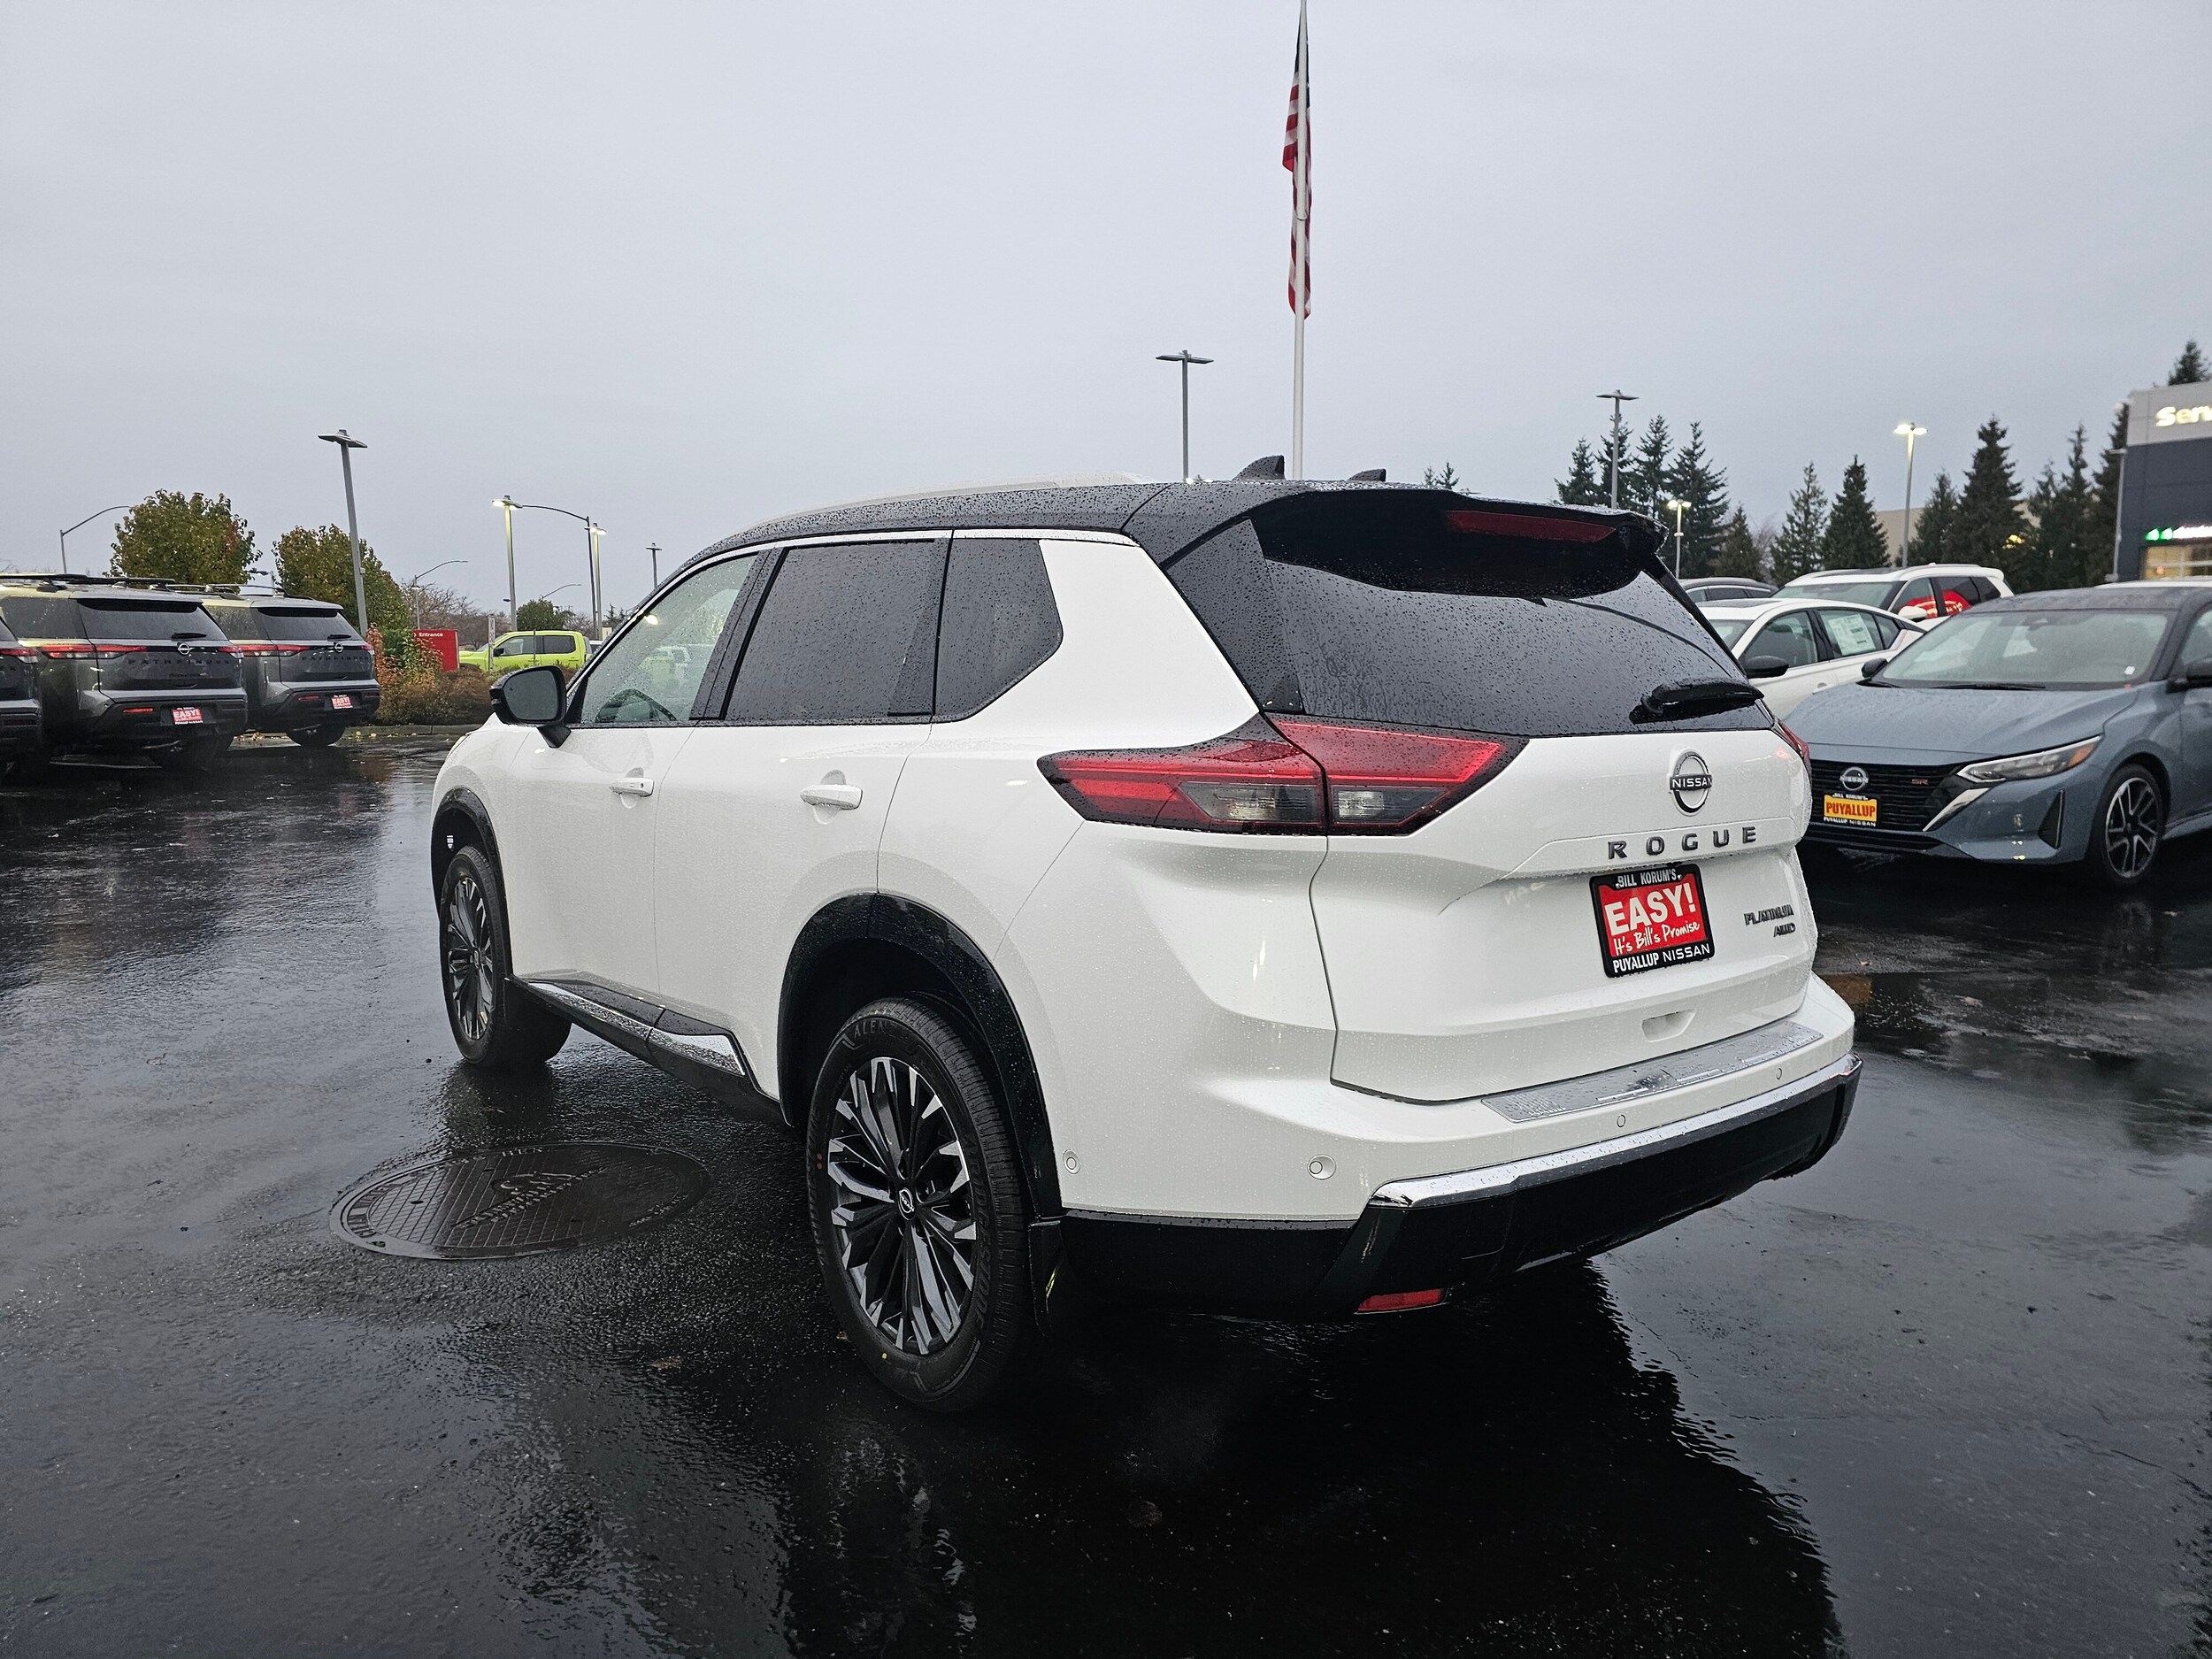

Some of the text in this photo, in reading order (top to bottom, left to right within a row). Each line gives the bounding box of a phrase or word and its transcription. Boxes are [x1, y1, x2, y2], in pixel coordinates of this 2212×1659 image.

[1671, 776, 1713, 788] NISSAN
[1825, 802, 1876, 818] PUYALLUP
[1608, 826, 1757, 859] ROGUE
[1617, 868, 1677, 887] BILL KORUM'S
[1604, 883, 1696, 936] EASY!
[1614, 921, 1700, 956] It's Bill's Promise
[1613, 943, 1710, 973] PUYALLUP NISSAN
